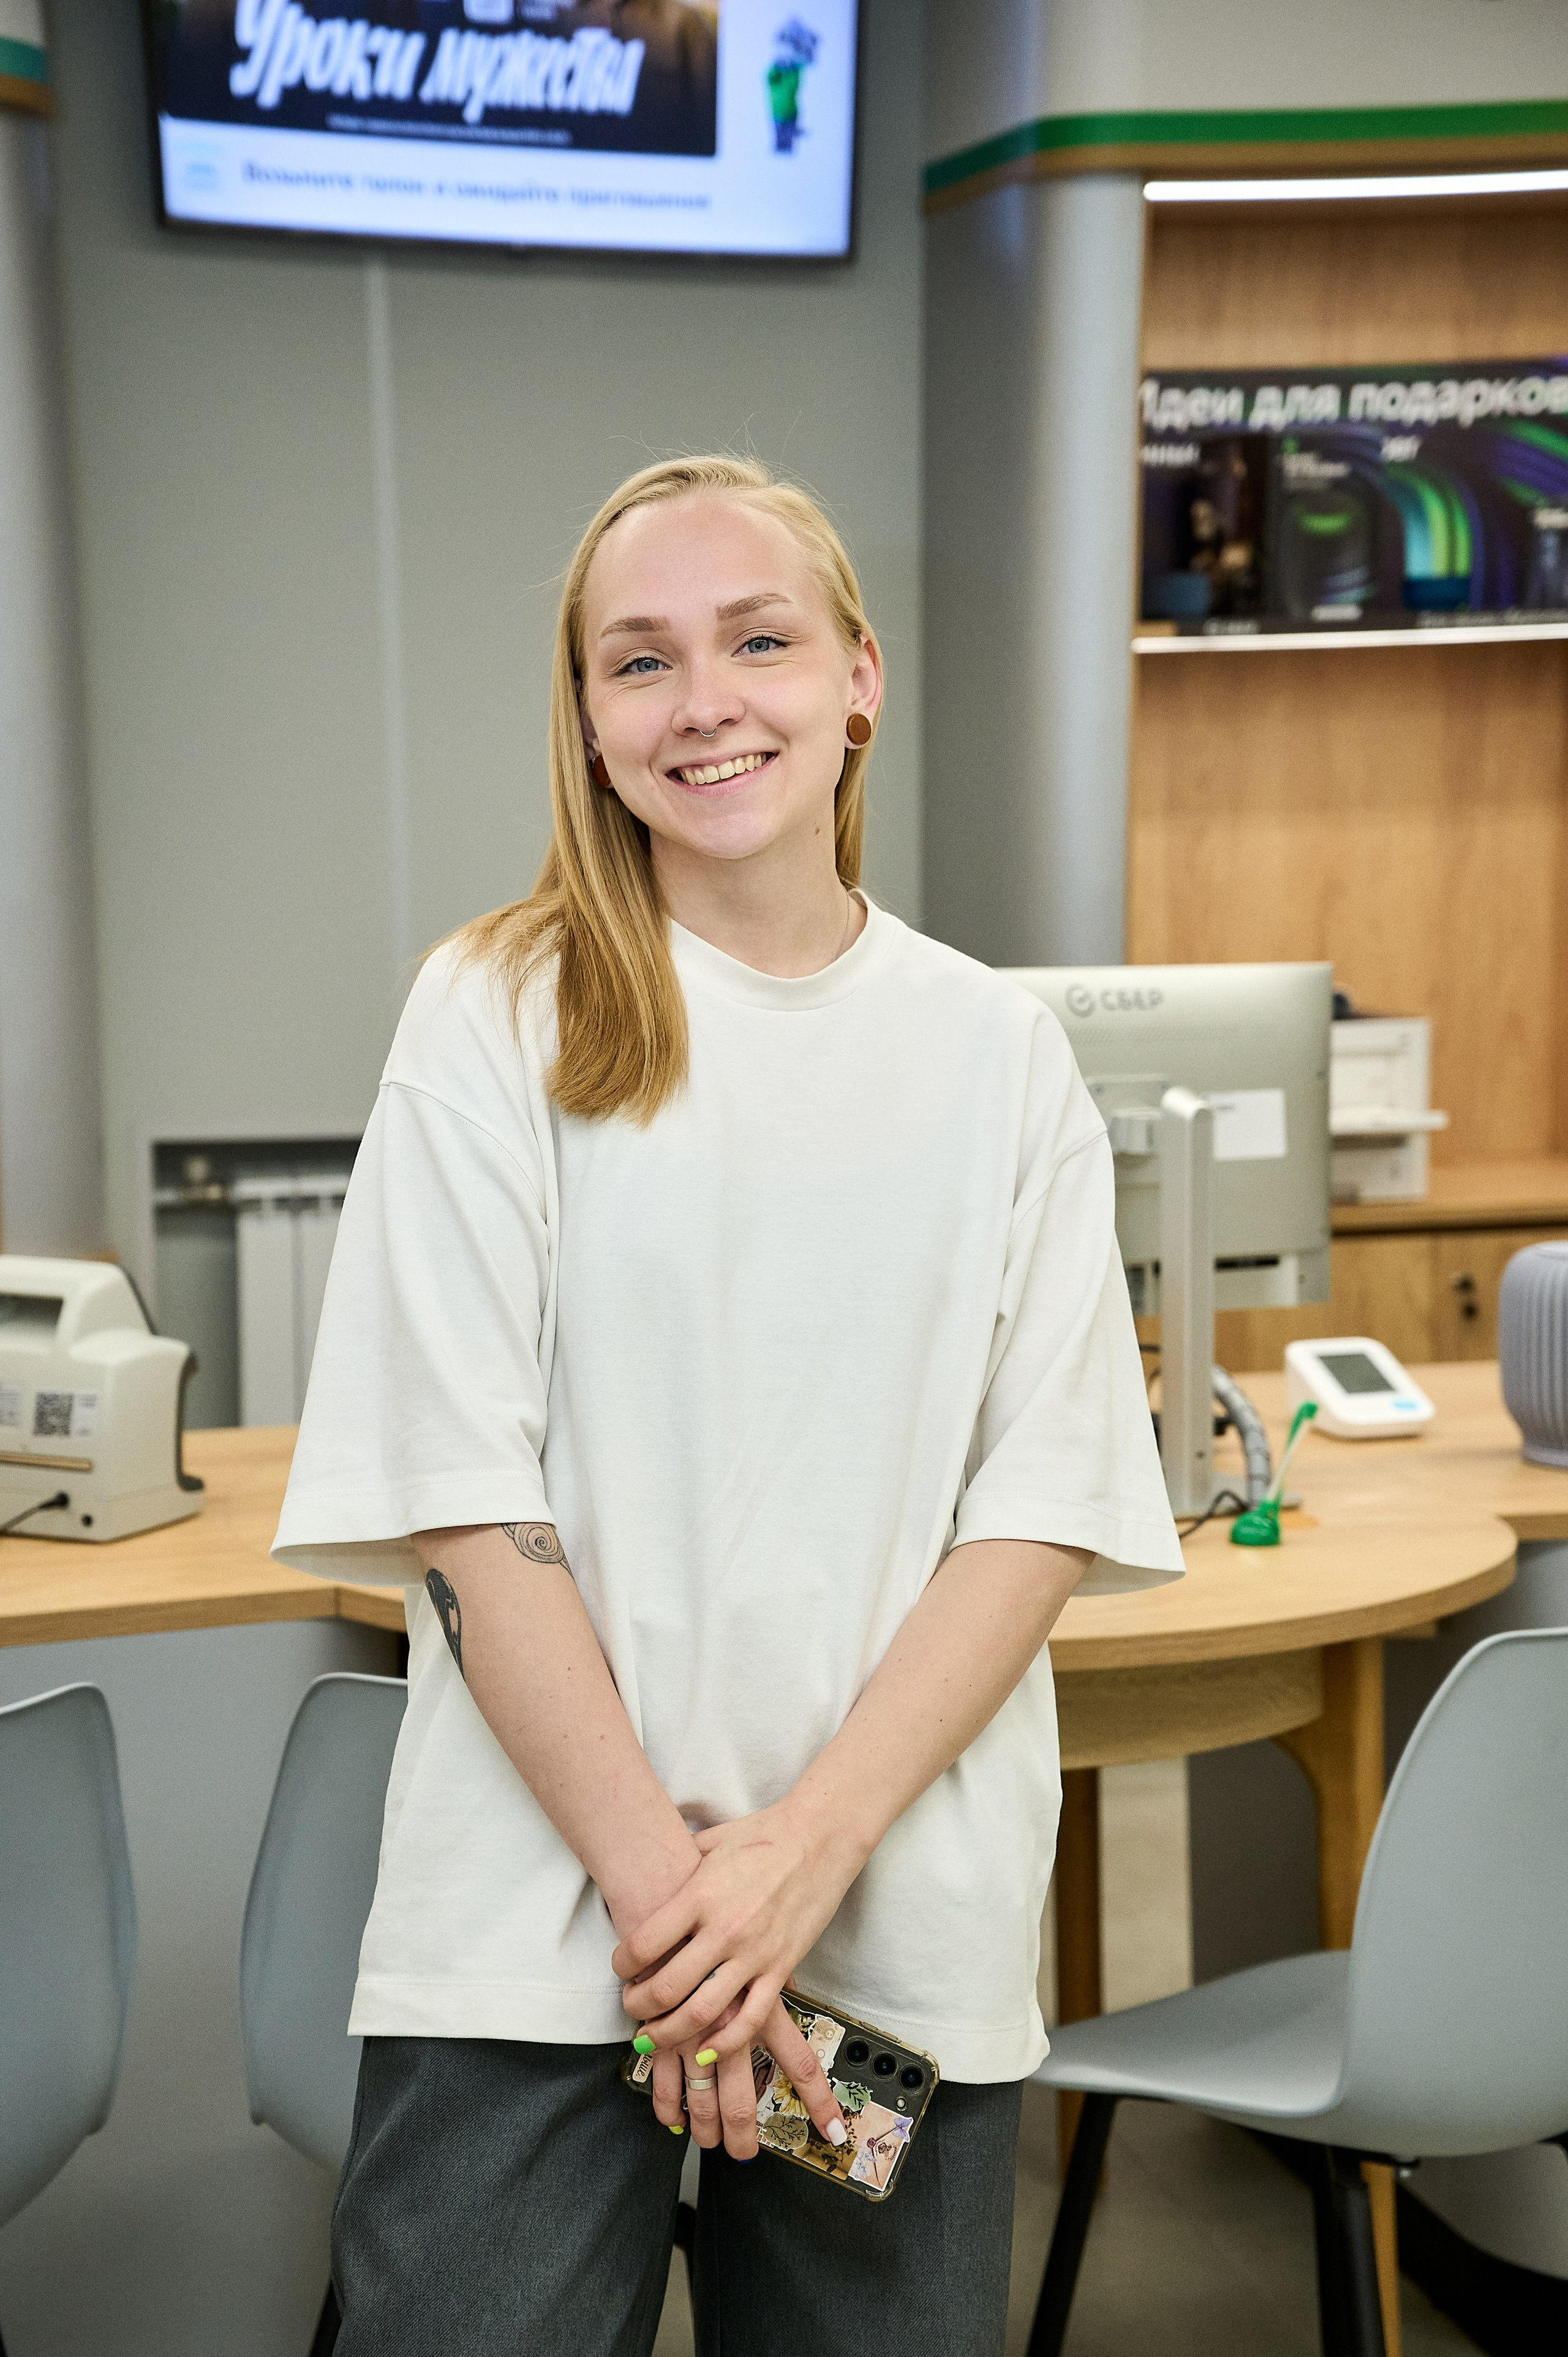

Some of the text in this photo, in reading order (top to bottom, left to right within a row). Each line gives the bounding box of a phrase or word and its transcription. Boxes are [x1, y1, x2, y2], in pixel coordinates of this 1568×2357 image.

[229, 0, 427, 110] Уроки
[1250, 384, 1342, 430] для
[1100, 986, 1164, 1012] СБЕР
[636, 2052, 653, 2077] льше.
